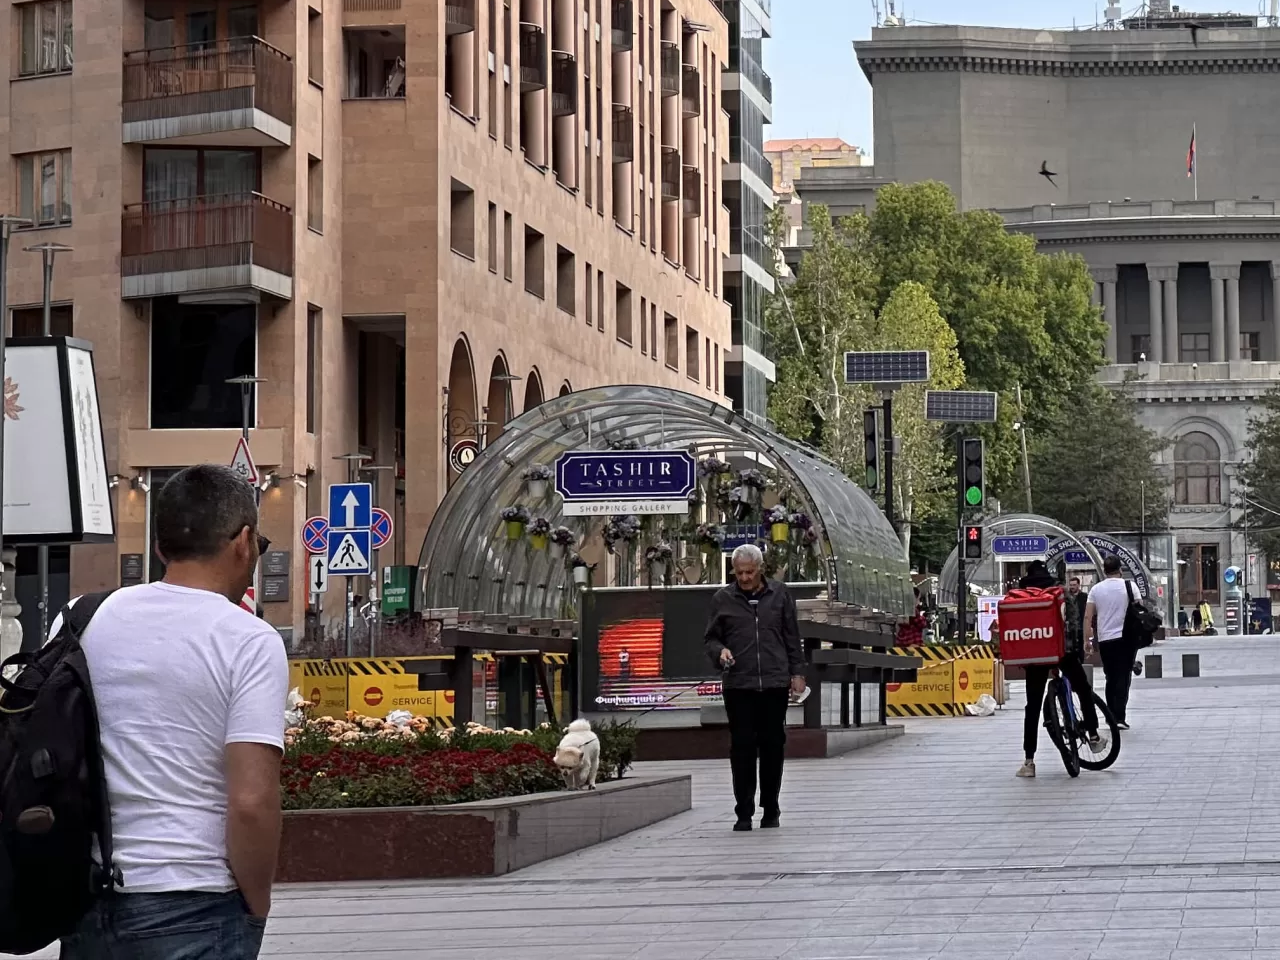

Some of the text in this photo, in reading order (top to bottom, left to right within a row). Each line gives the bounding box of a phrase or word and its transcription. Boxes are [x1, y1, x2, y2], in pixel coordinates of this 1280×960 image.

[580, 461, 671, 476] TASHIR
[596, 479, 654, 487] STREET
[580, 504, 671, 513] SHOPPING GALLERY
[1001, 539, 1039, 547] TASHIR
[1093, 538, 1116, 551] CENTRE
[1004, 626, 1053, 641] menu
[911, 683, 950, 692] SERVICE
[972, 682, 992, 690] SERVICE
[392, 697, 432, 706] SERVICE
